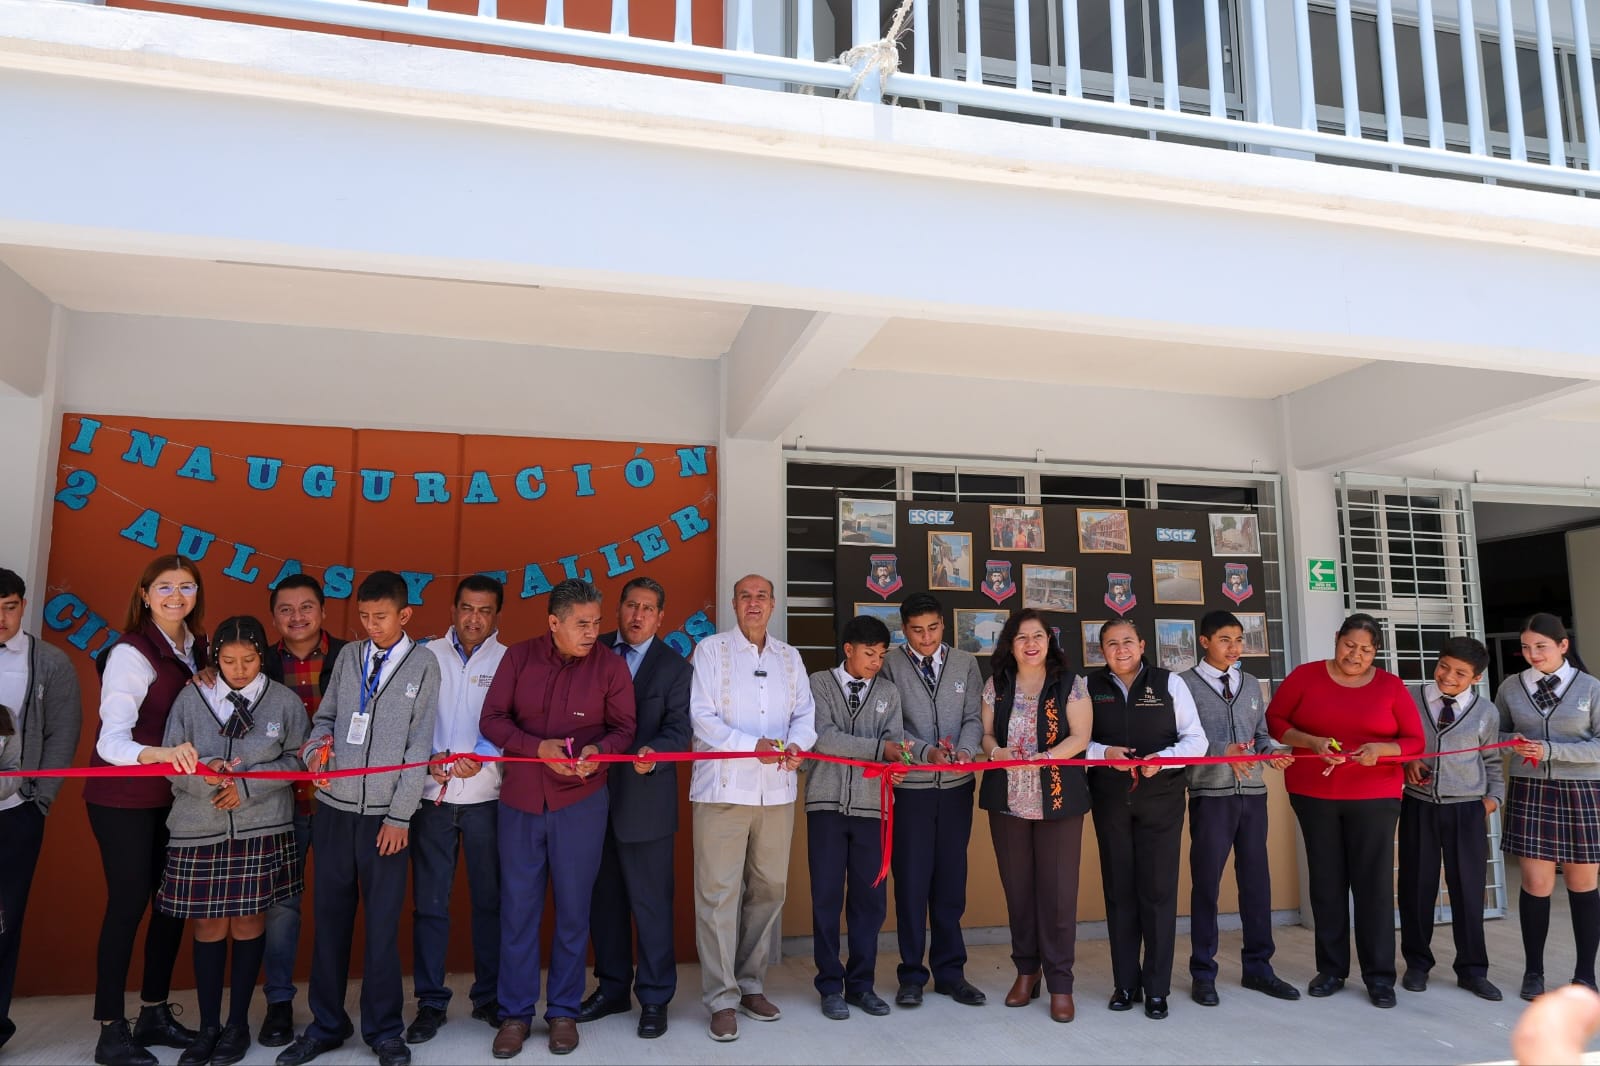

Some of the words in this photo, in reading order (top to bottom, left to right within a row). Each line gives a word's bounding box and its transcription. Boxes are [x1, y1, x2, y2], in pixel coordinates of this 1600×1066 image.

[68, 416, 709, 504] INAUGURACIÓN
[54, 469, 98, 511] 2
[119, 508, 355, 599] AULAS
[400, 570, 434, 605] Y
[475, 505, 710, 599] ALLER
[908, 509, 955, 525] ESGEZ
[1156, 527, 1197, 542] ESGEZ
